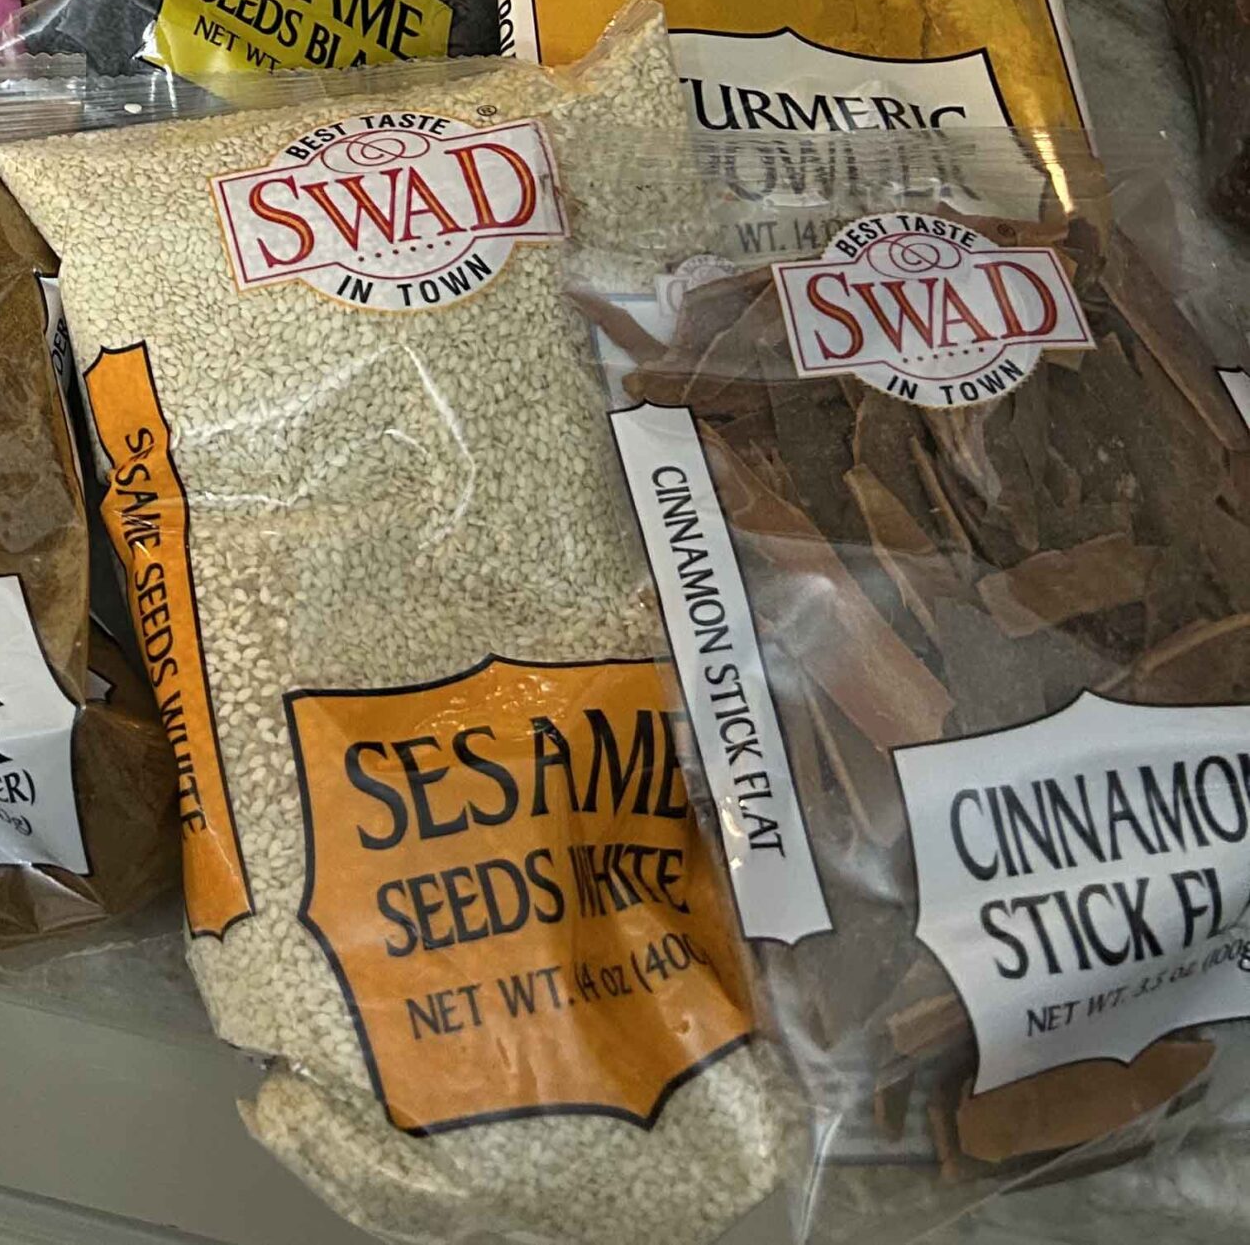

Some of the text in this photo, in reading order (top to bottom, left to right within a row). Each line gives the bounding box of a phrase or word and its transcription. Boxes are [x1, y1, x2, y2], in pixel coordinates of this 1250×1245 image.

[192, 15, 240, 52] NET
[285, 112, 451, 161] BEST TASTE
[678, 76, 968, 133] URMERIC
[248, 141, 538, 269] SWAD
[835, 217, 890, 258] BEST
[896, 214, 978, 249] TASTE
[336, 253, 494, 308] IN TOWN
[806, 260, 1059, 361] SWAD
[886, 358, 1025, 406] IN TOWN
[134, 561, 180, 688] SEEDS
[651, 464, 787, 859] CINNAMON STICK FLAT
[344, 707, 690, 852] SESAME
[375, 847, 566, 957] SEEDS
[980, 876, 1165, 980] STICK
[405, 982, 483, 1041] NET
[497, 964, 576, 1020] WT.
[602, 963, 634, 995] oz
[1026, 1000, 1081, 1038] NET
